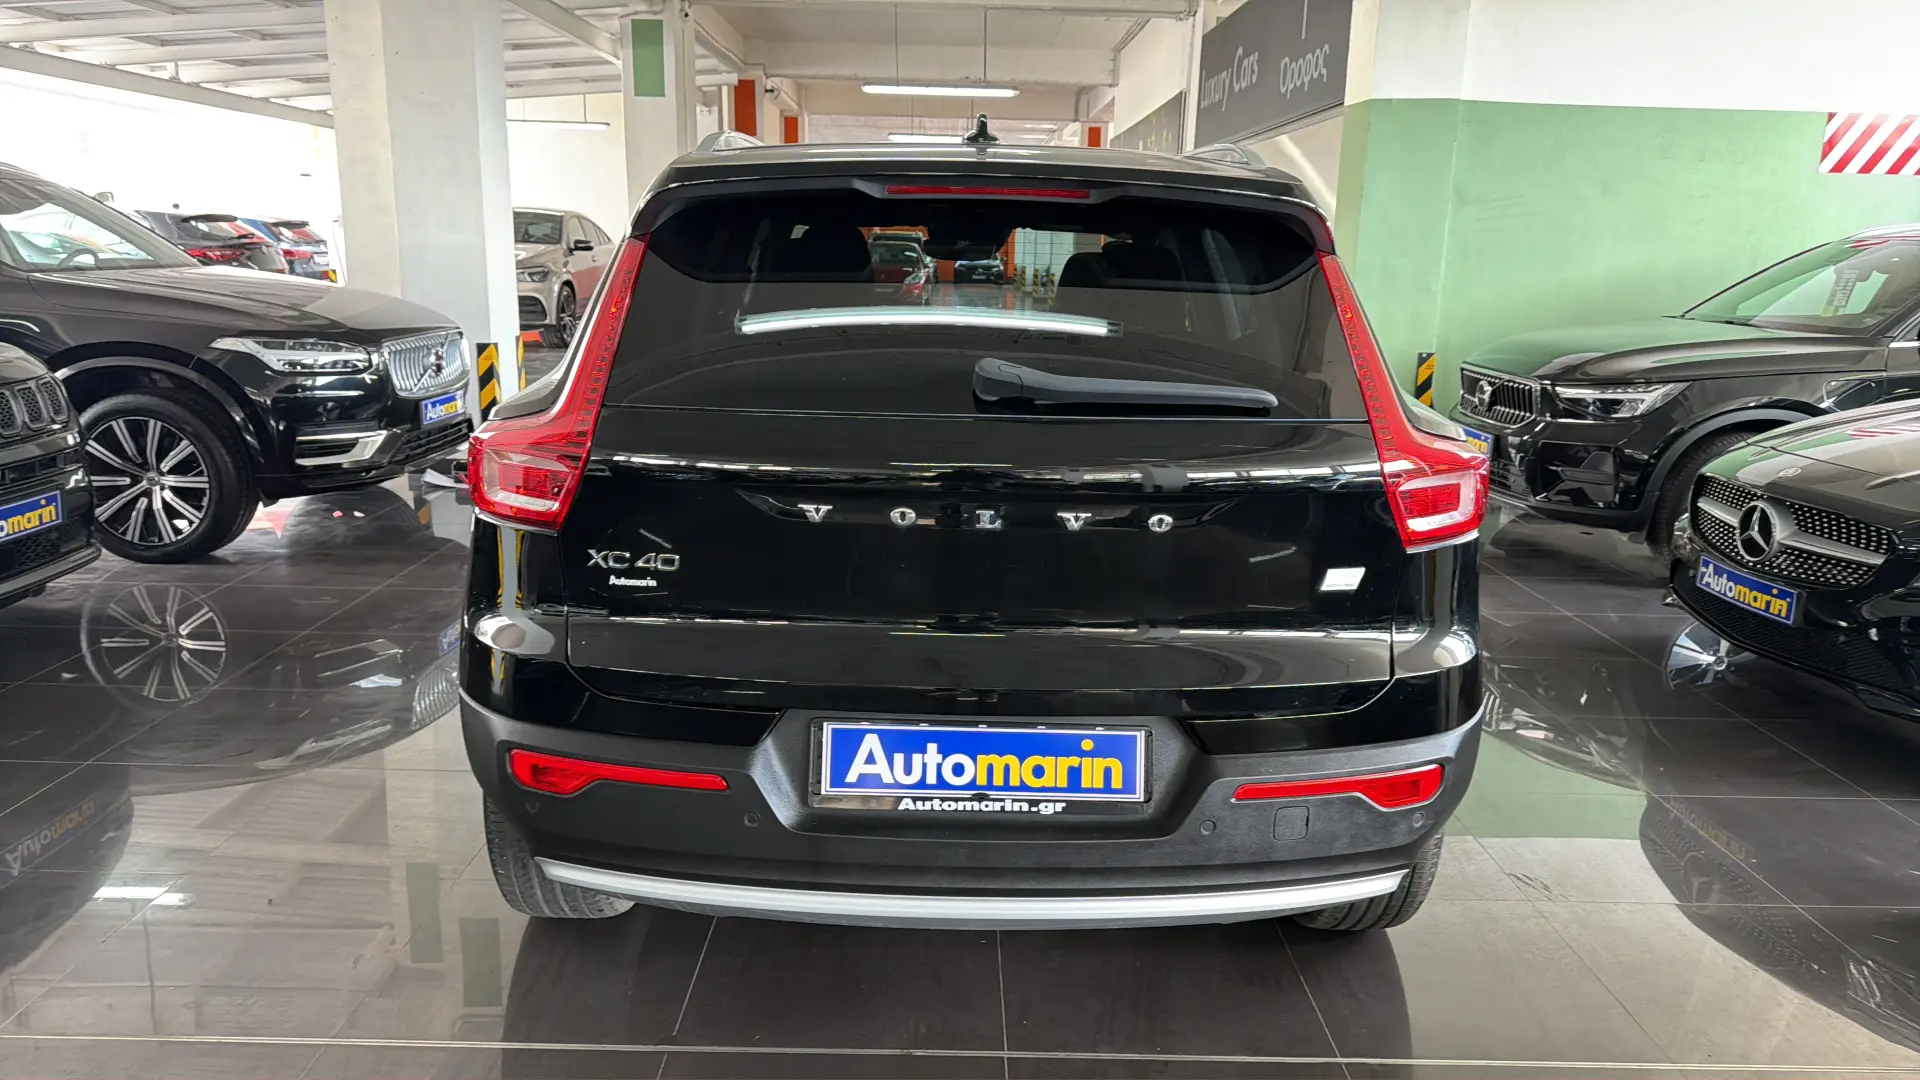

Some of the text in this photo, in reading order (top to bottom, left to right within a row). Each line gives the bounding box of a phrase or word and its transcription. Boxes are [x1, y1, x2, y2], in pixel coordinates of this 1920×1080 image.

[1200, 46, 1259, 111] Luxury Cars
[798, 504, 1174, 533] VOLVO
[608, 574, 657, 587] Automarin
[1701, 563, 1788, 618] Automarin
[844, 733, 1123, 789] Automarin
[897, 797, 1066, 815] Automarin.gr
